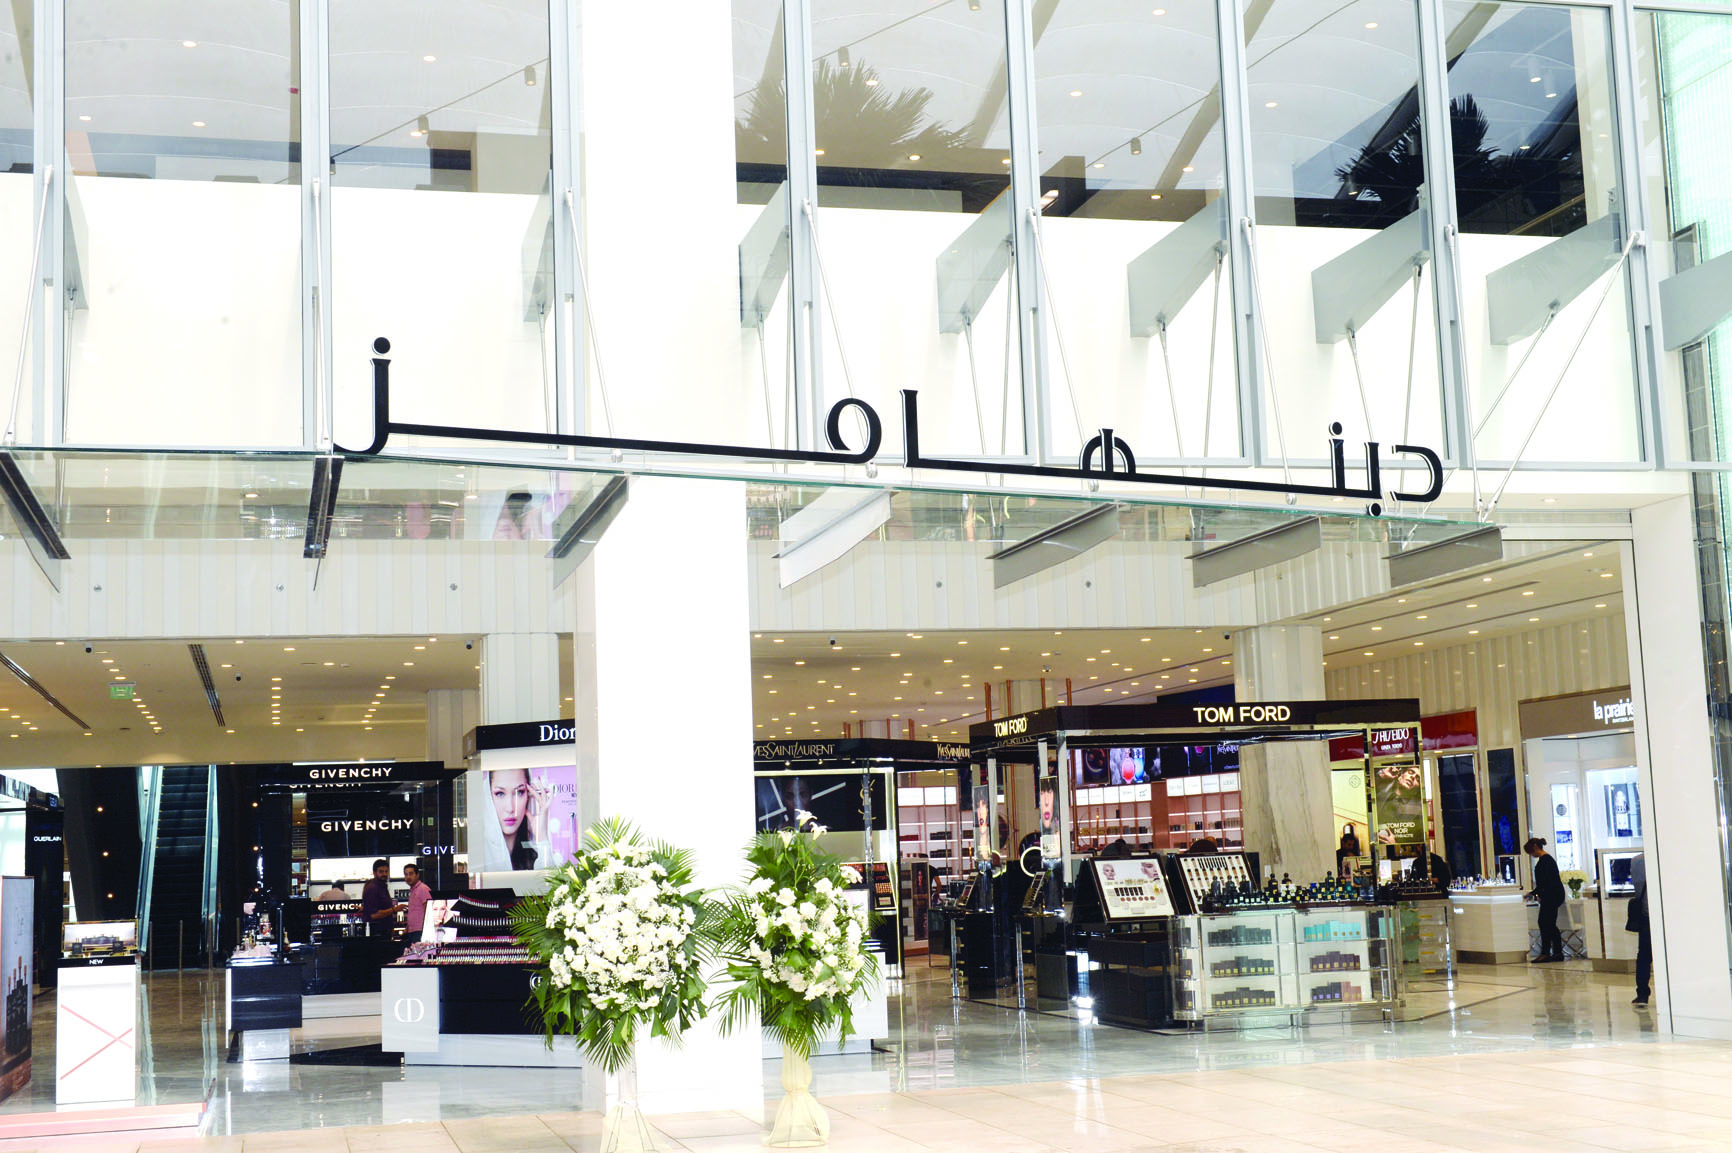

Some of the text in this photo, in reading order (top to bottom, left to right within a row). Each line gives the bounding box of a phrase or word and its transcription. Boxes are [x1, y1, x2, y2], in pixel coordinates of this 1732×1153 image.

[1193, 705, 1291, 723] TOM FORD
[1593, 700, 1604, 720] la
[994, 717, 1027, 737] TOM FORD
[309, 767, 393, 779] GIVENCHY
[320, 819, 414, 832] GIVENCHY
